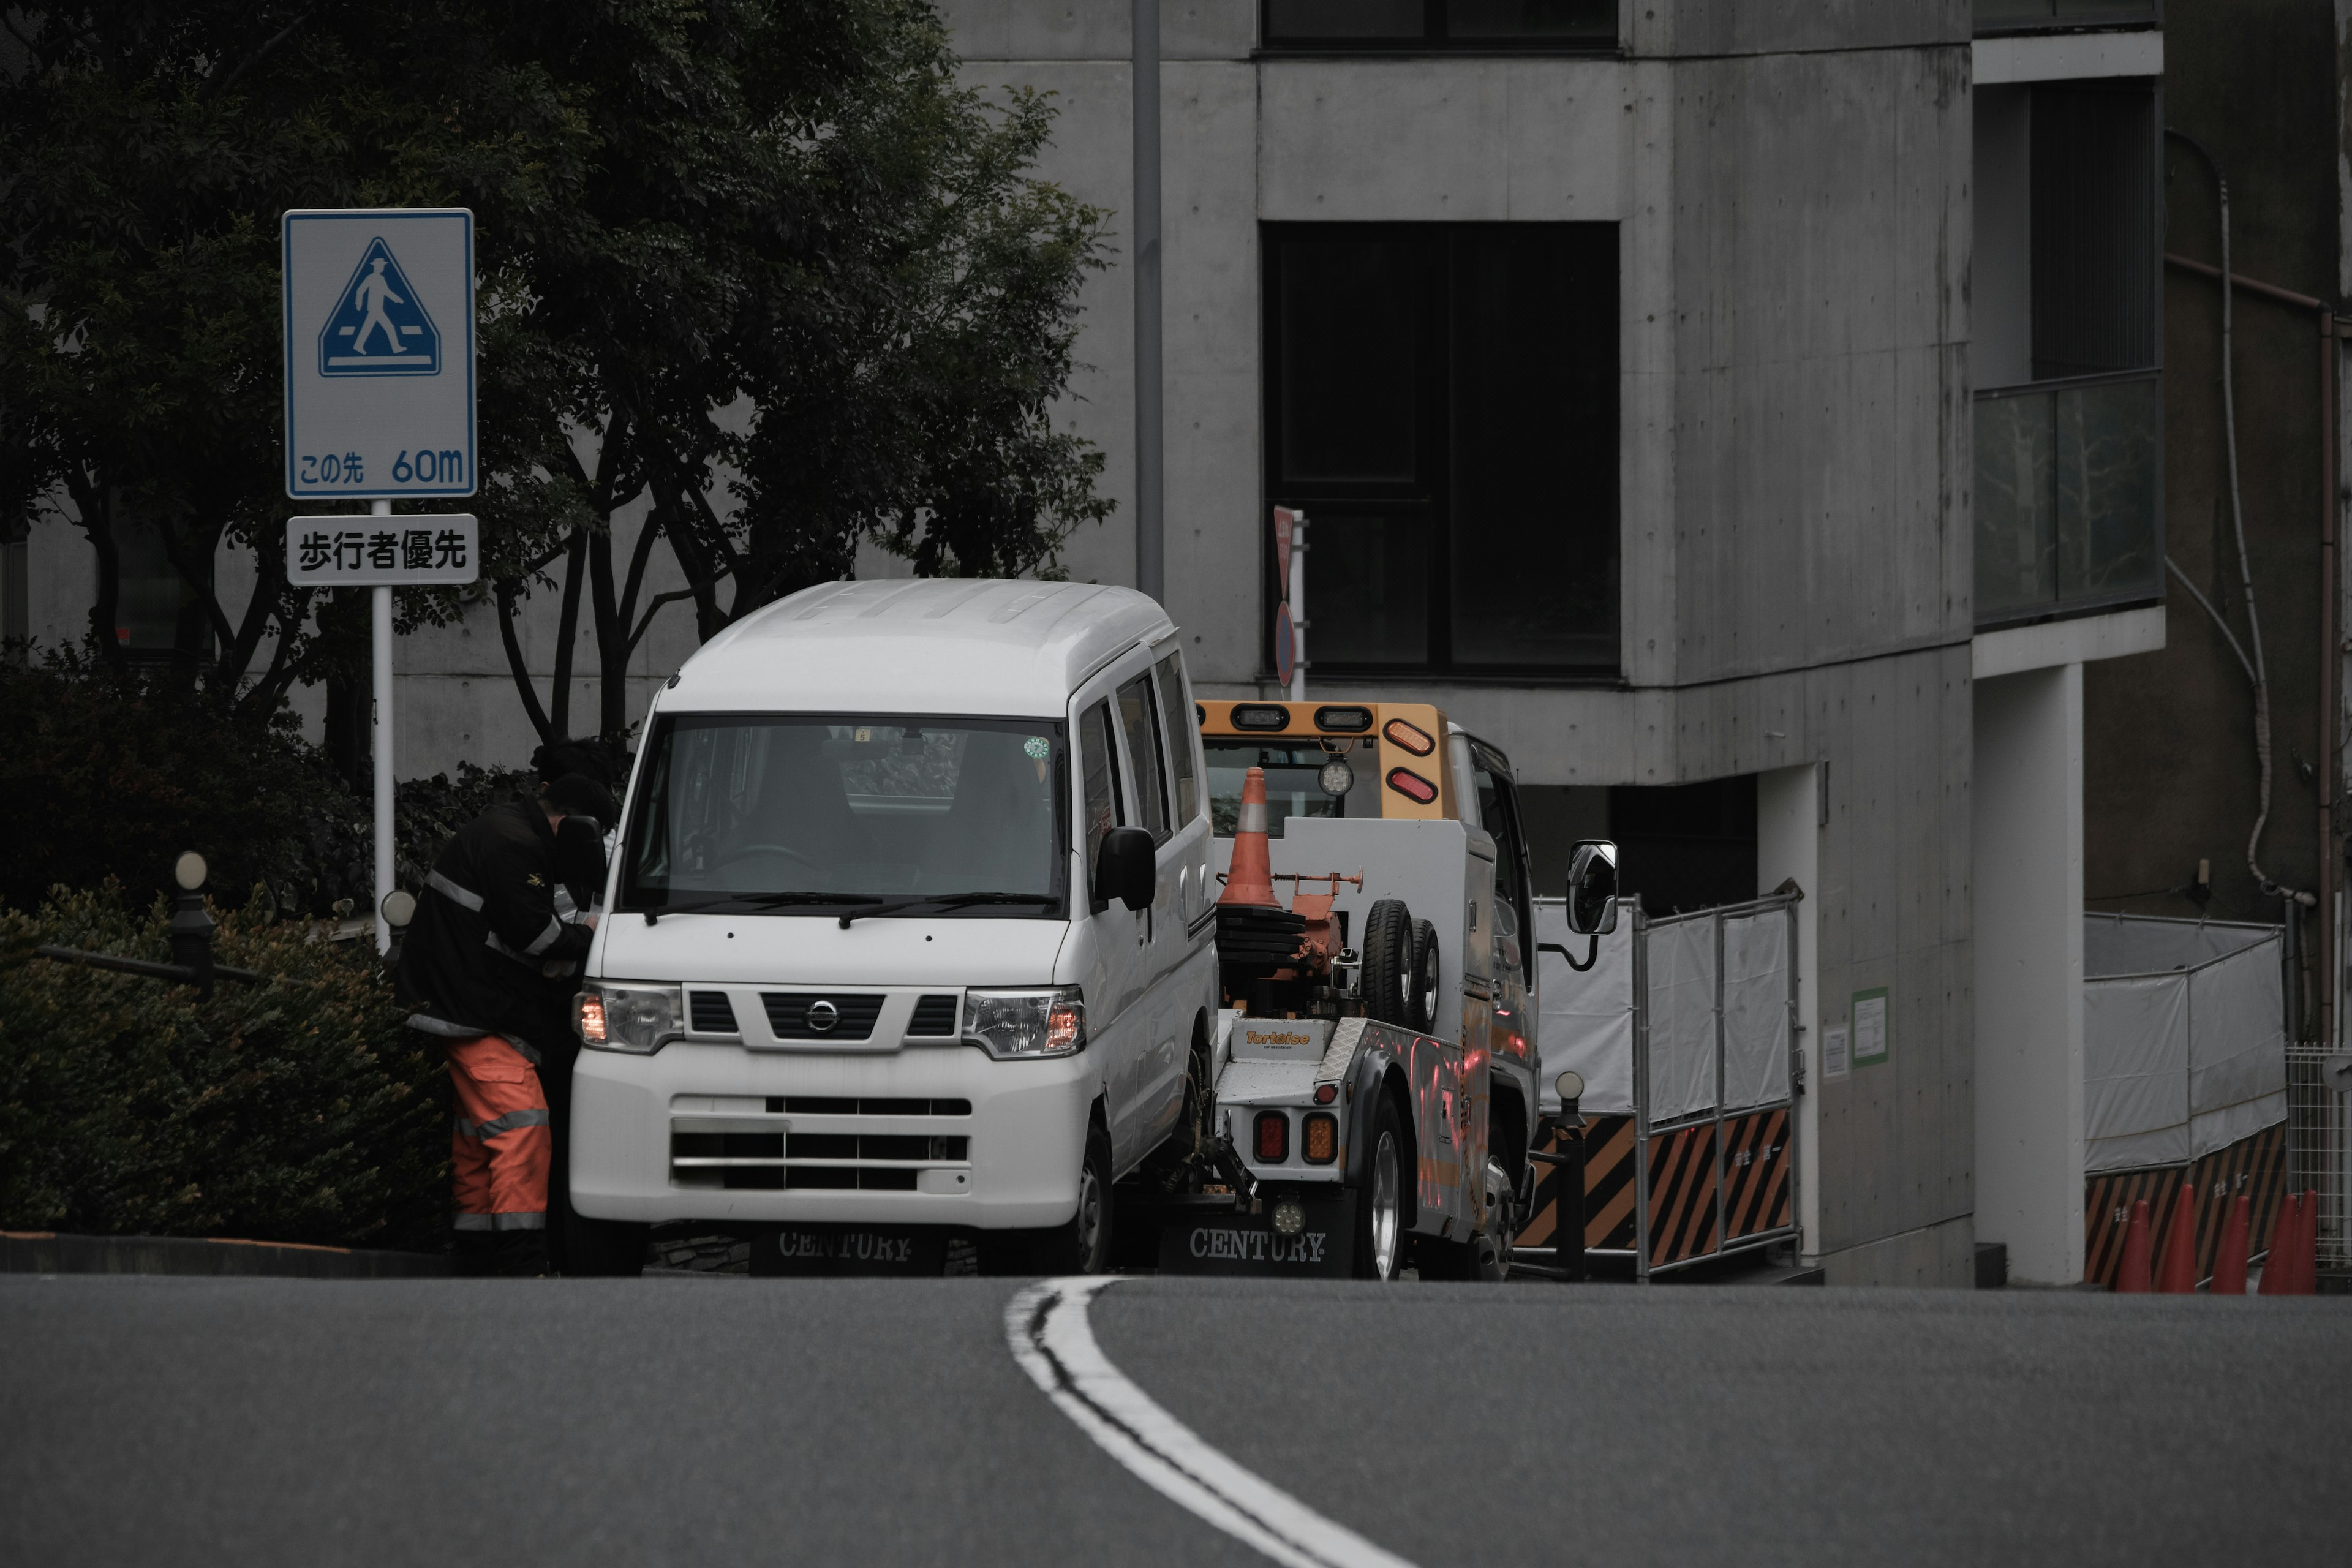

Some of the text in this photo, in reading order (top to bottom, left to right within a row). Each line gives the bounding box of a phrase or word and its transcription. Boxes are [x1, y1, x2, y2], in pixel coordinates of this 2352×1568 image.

[301, 450, 462, 484] この先 60m
[299, 529, 466, 571] 歩行者優先
[1246, 1031, 1310, 1045] Tortoise
[779, 1232, 910, 1262] CENTURY
[1189, 1227, 1325, 1262] CENTURY
